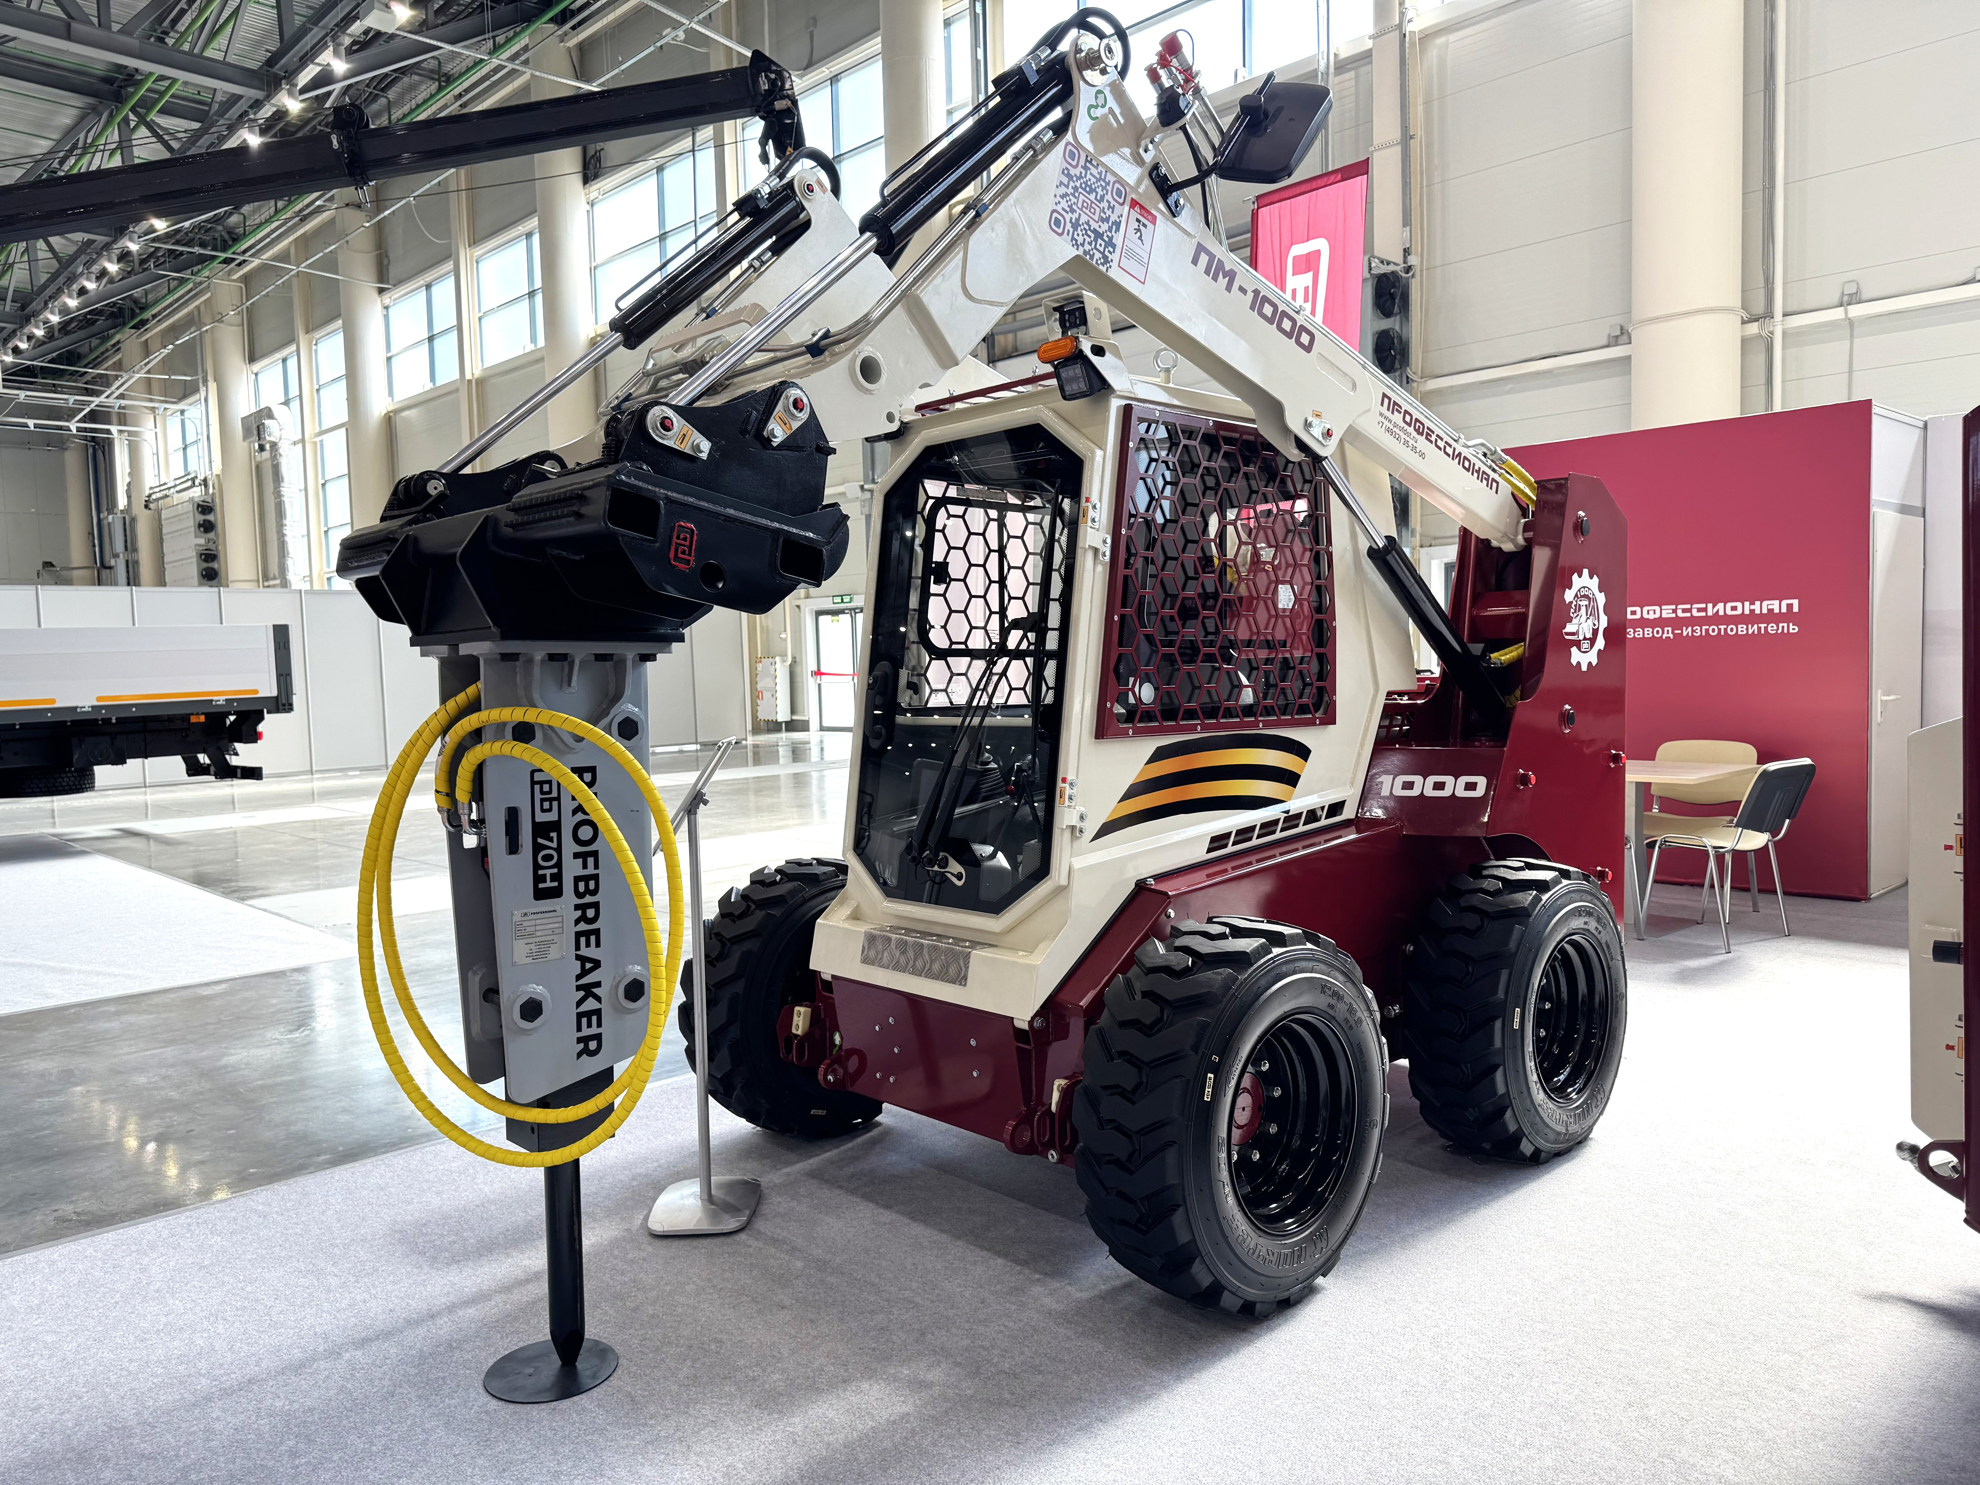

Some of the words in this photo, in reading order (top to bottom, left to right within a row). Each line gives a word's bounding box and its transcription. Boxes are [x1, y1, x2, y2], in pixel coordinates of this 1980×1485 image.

[1190, 241, 1316, 354] ПМ-1000
[1379, 391, 1500, 495] ПРОФЕССИОНАЛ
[1376, 775, 1488, 798] 1000
[537, 831, 559, 889] 70H
